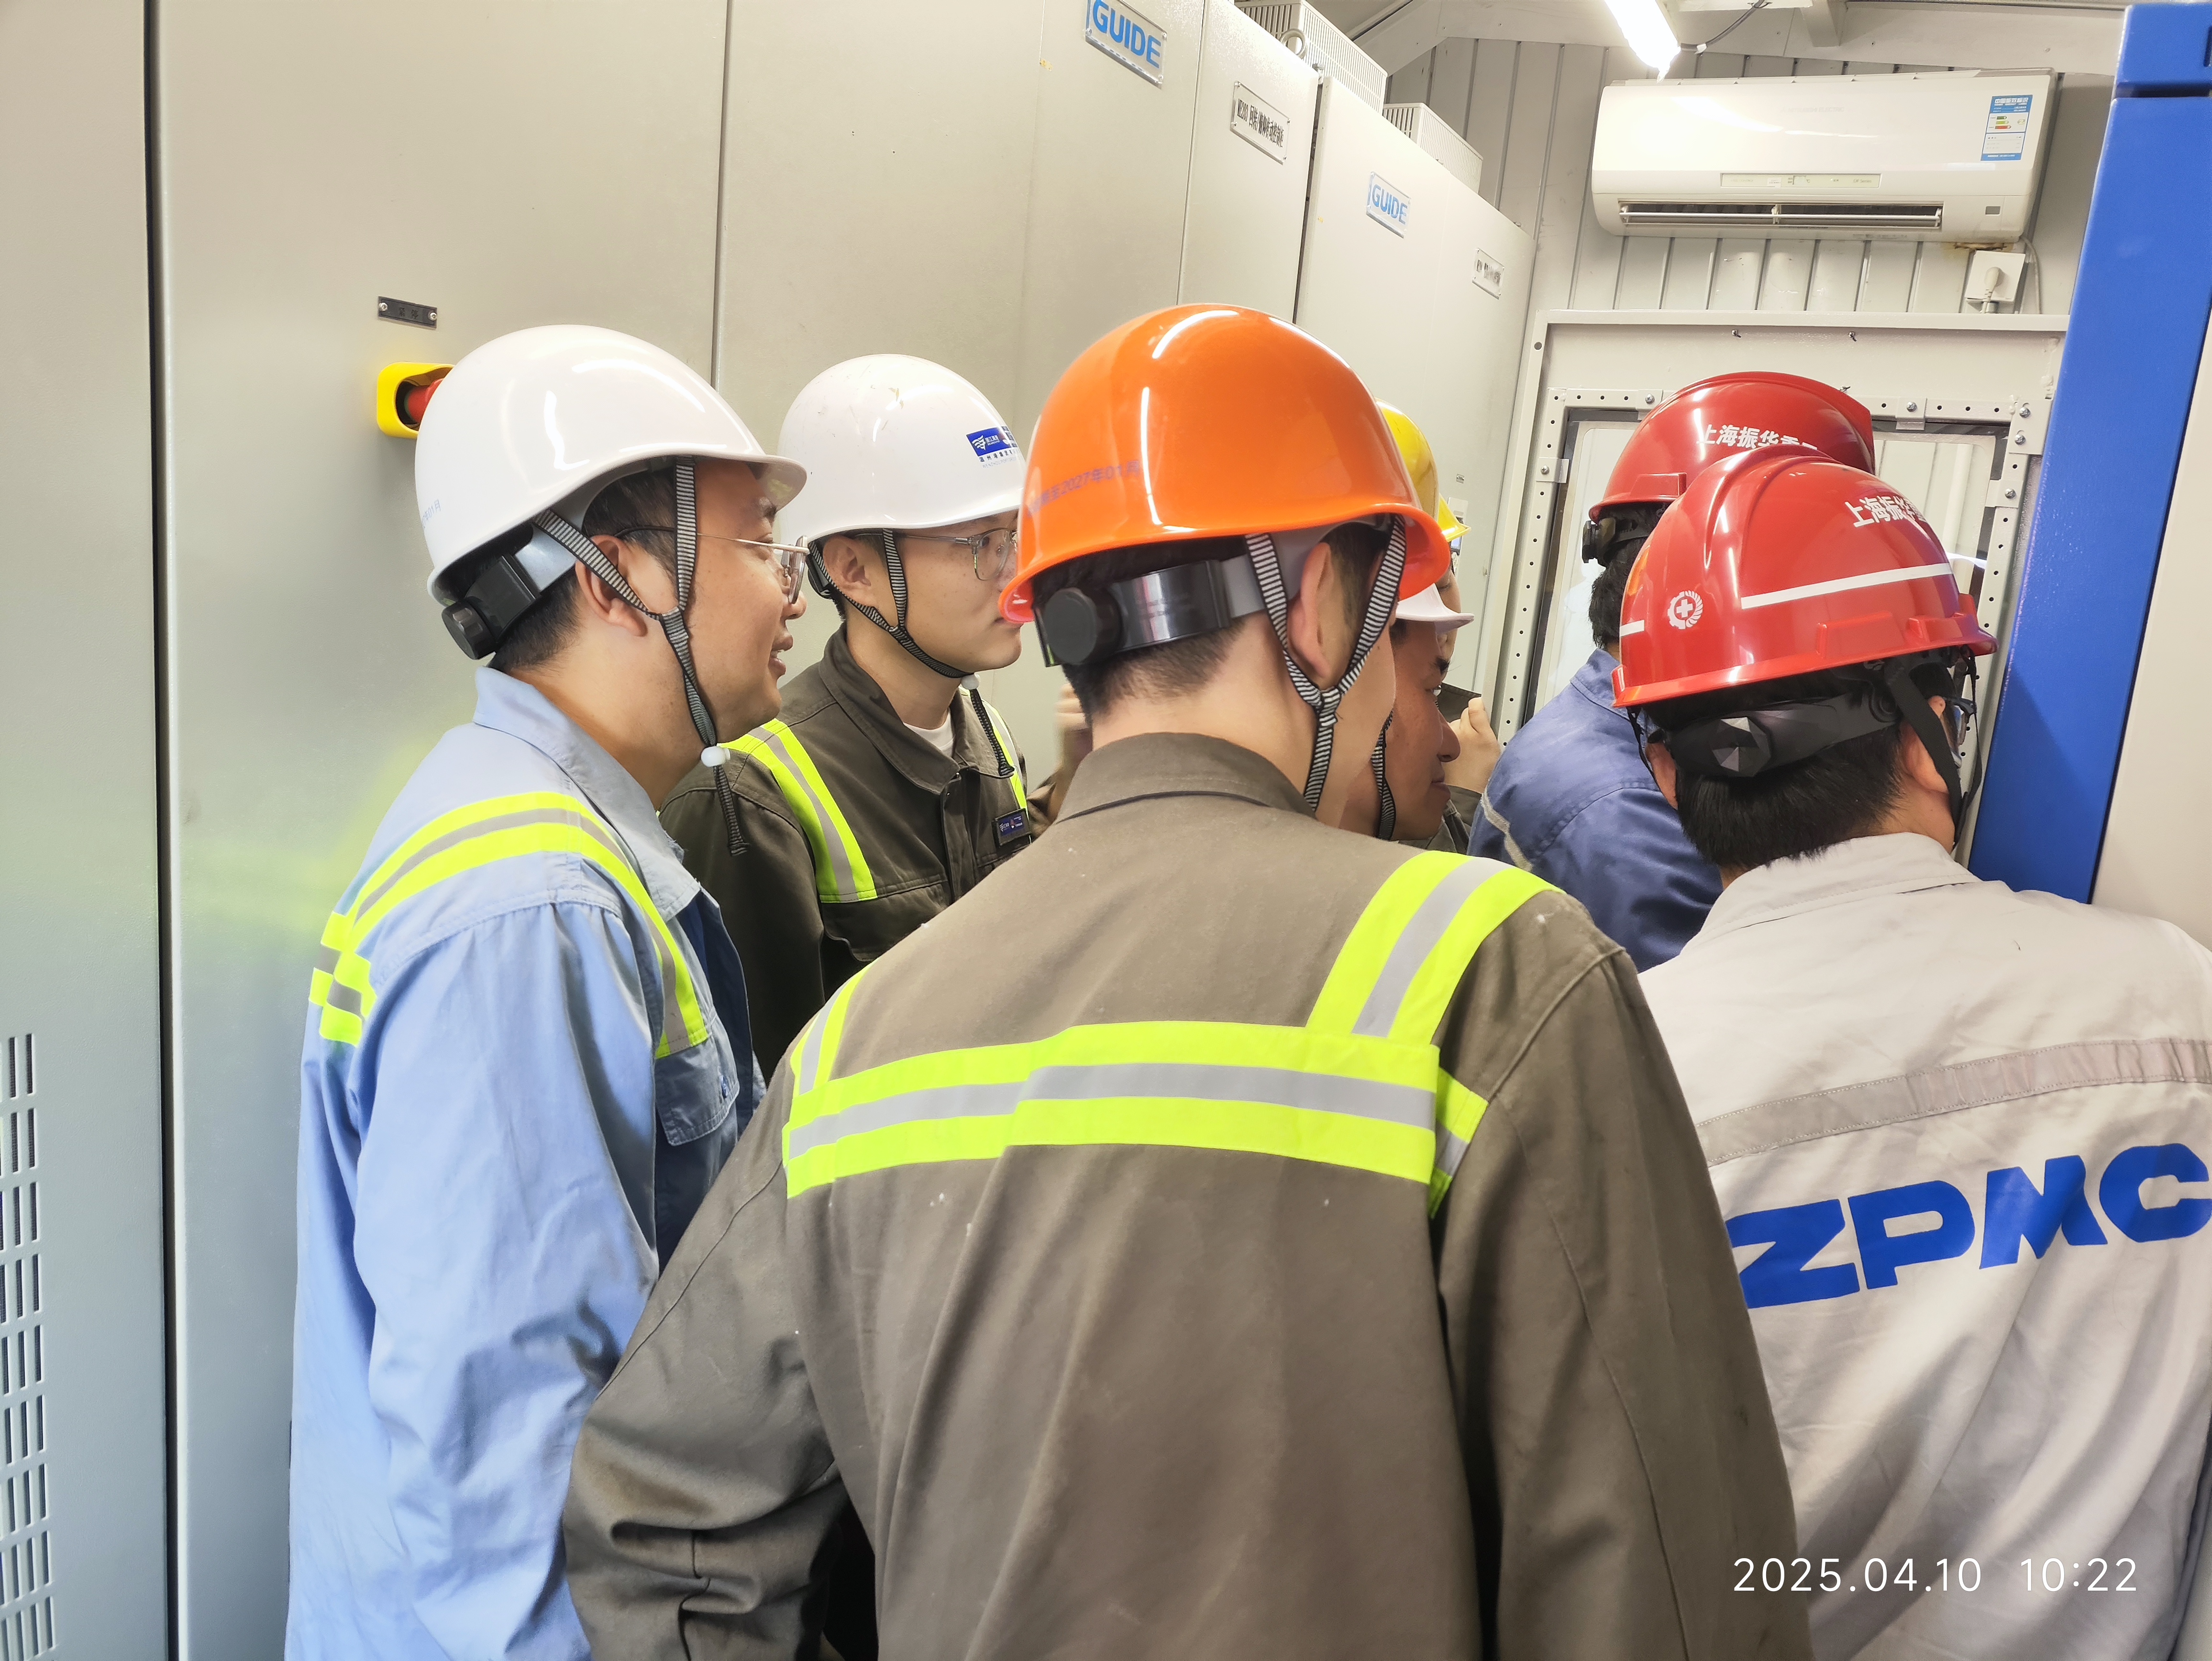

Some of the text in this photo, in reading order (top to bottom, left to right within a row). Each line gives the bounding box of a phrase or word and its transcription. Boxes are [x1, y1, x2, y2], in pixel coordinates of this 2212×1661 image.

[1093, 0, 1161, 68] GUIDE
[1371, 184, 1408, 225] GUIDE
[1696, 424, 1818, 450] 上海振华
[1725, 1143, 2212, 1309] ZPMC
